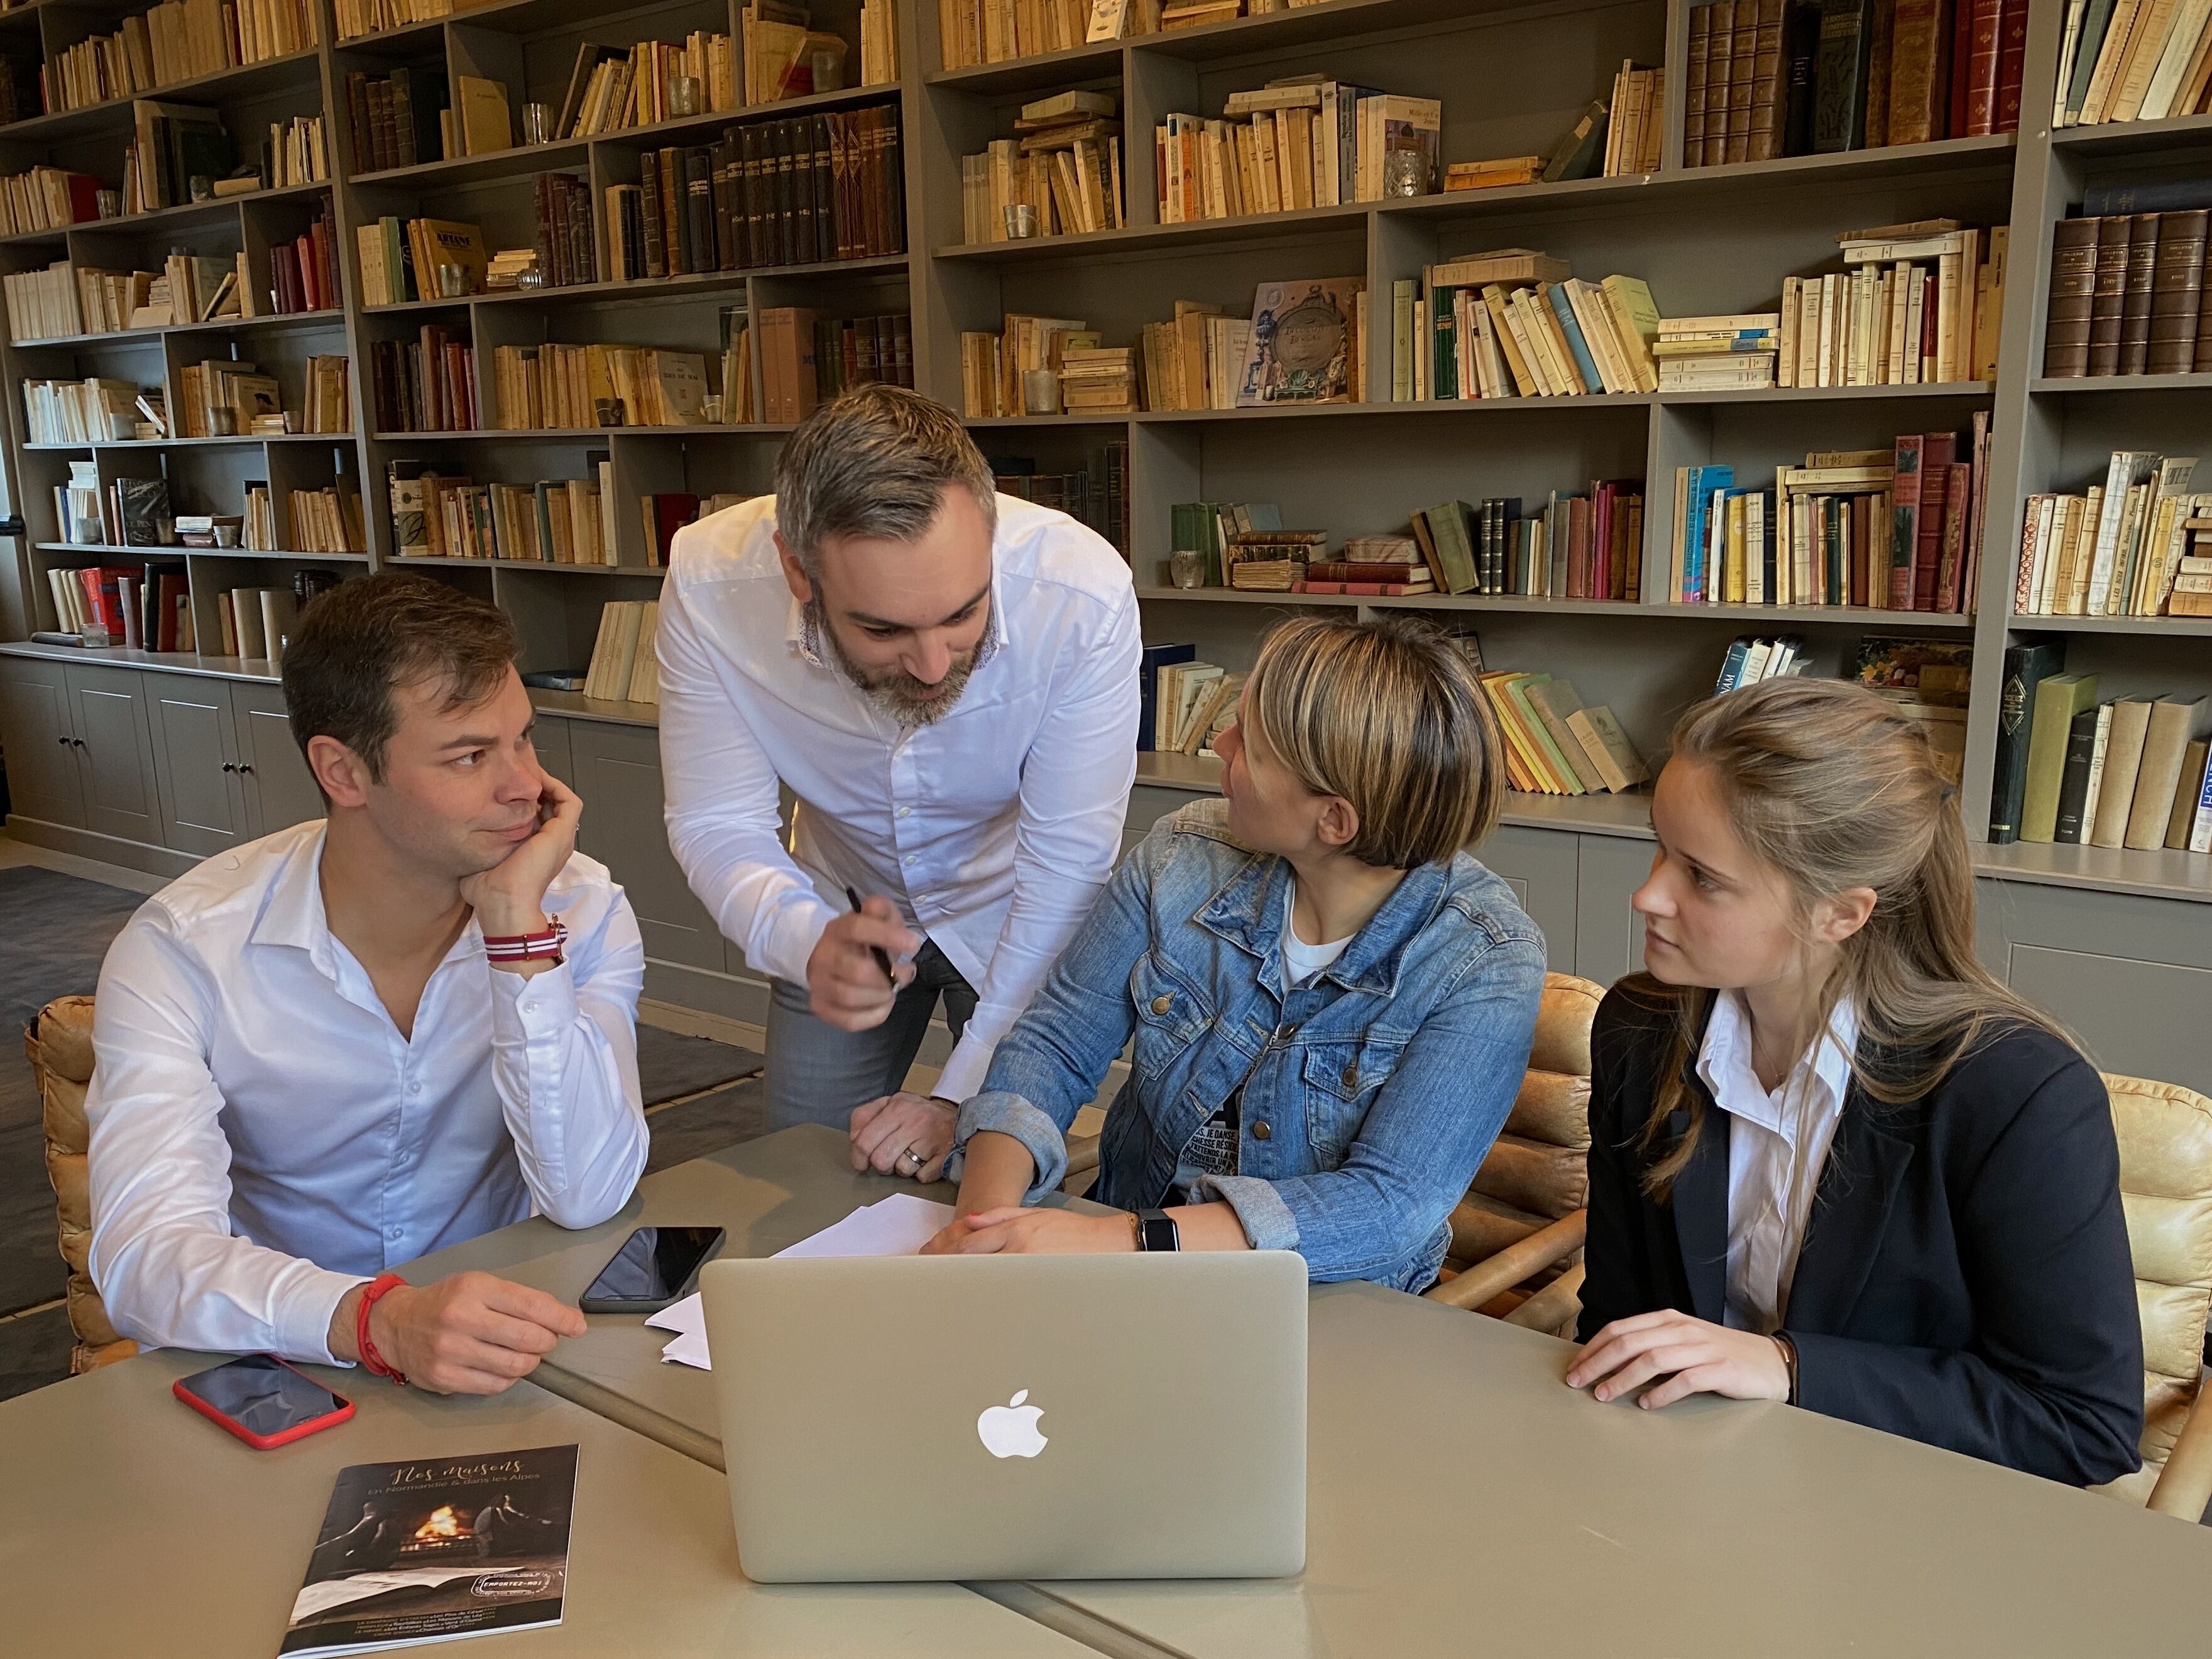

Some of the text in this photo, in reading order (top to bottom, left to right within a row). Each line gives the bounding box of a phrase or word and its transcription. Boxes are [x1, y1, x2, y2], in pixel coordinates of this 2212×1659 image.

[1207, 1129, 1215, 1138] JE
[385, 1481, 448, 1494] Normandie
[463, 1477, 489, 1485] dans
[509, 1472, 540, 1481] Alpes
[390, 1466, 436, 1485] Nos
